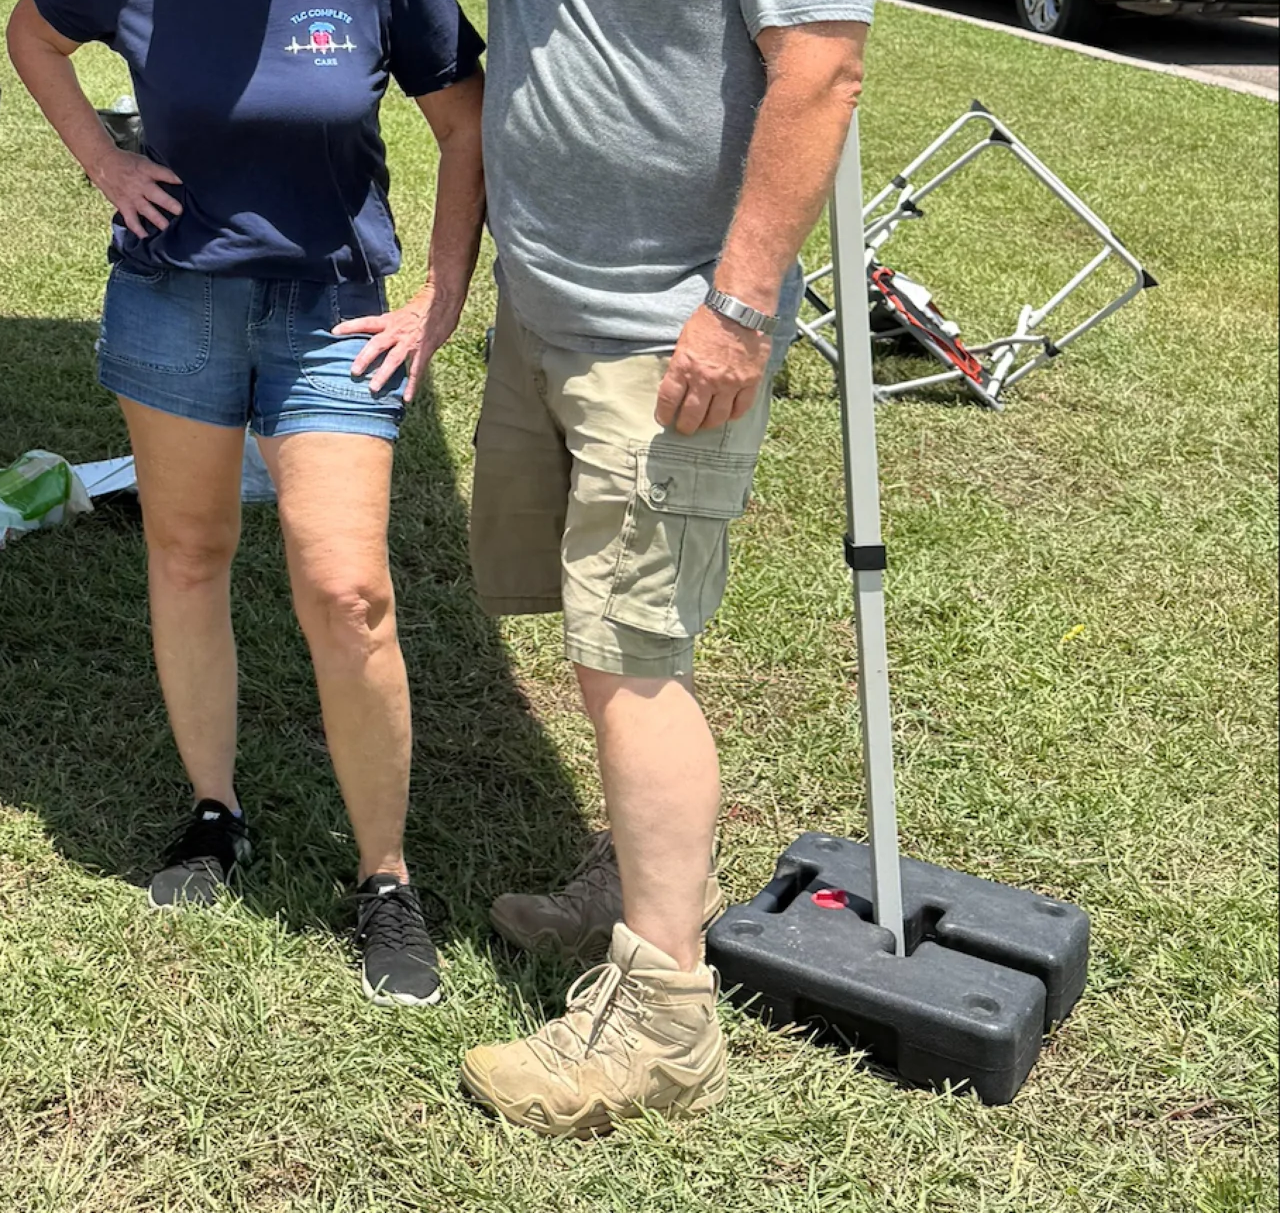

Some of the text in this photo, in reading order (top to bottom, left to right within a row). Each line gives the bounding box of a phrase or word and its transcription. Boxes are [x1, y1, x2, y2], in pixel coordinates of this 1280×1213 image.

[290, 8, 353, 24] TLC COMPLETE
[314, 57, 338, 66] CARE
